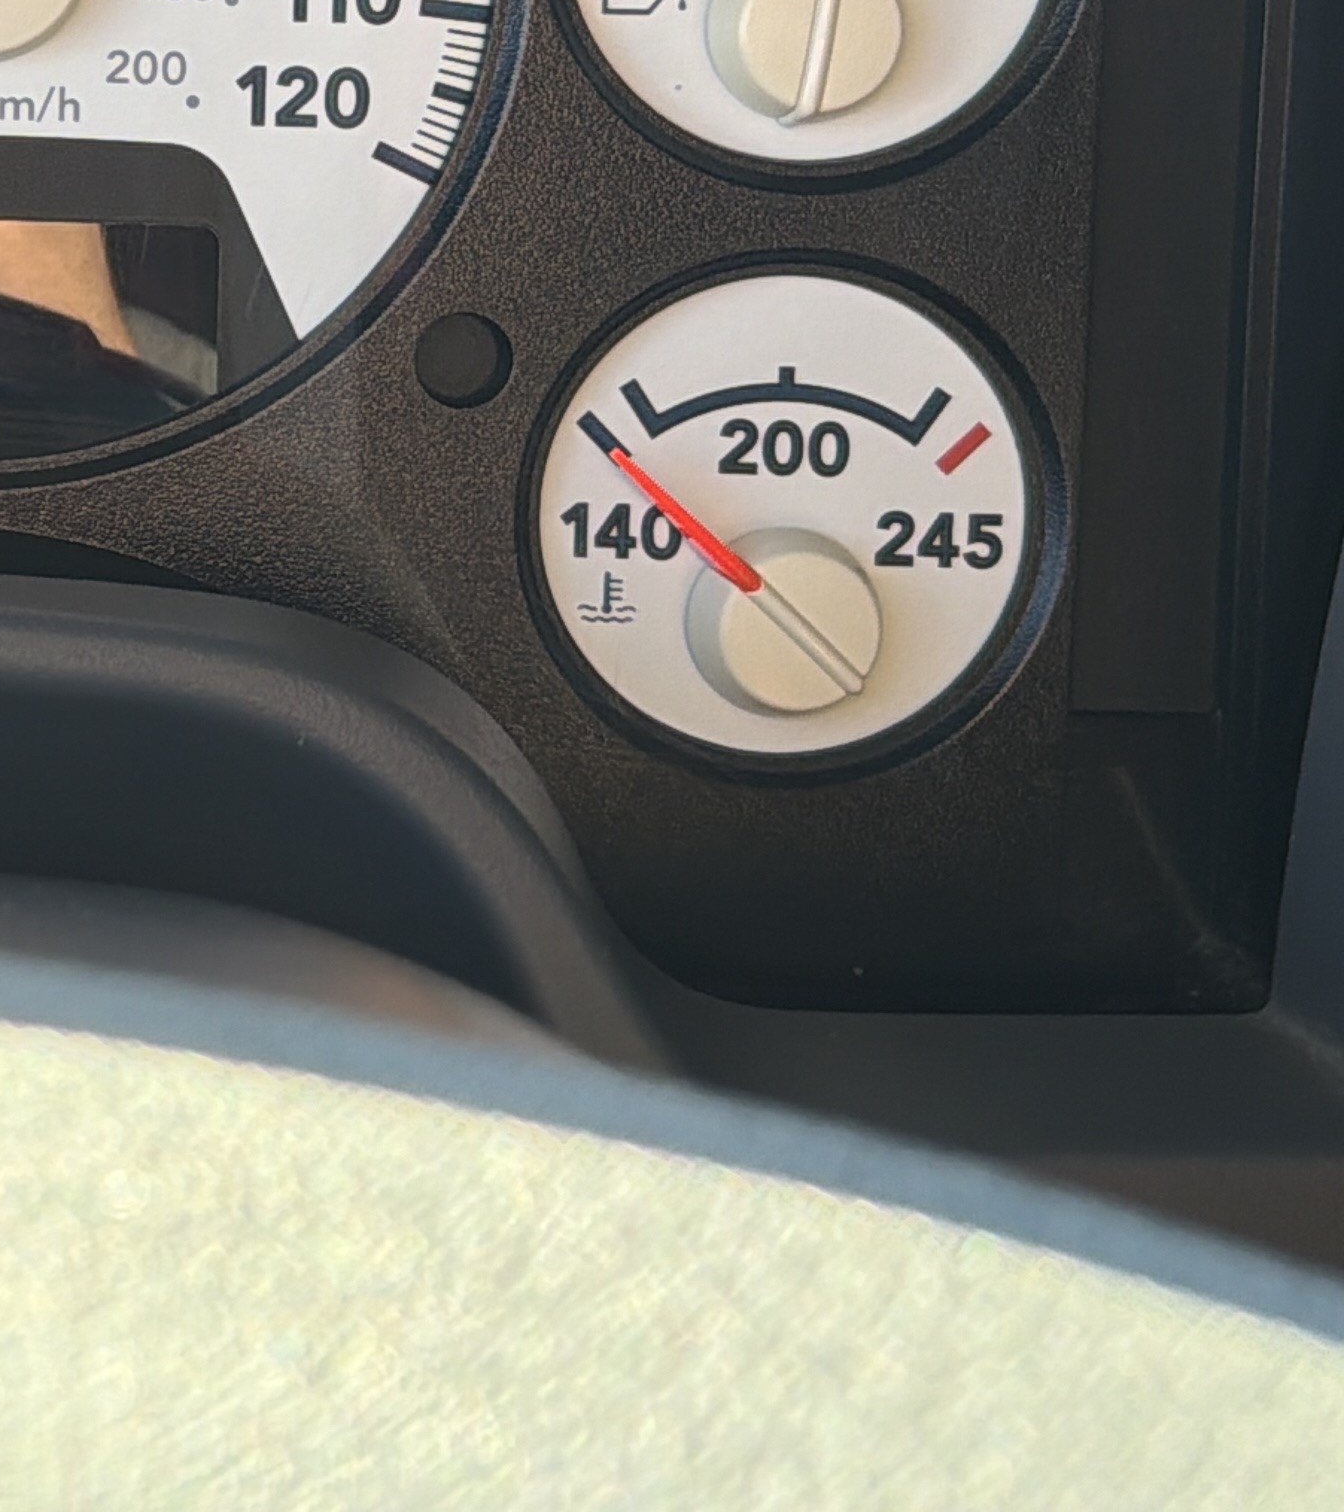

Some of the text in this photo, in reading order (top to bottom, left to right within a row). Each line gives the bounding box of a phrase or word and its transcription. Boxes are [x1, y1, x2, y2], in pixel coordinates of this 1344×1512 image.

[105, 50, 186, 85] 200
[236, 65, 370, 129] 120
[717, 419, 850, 477] 200
[560, 501, 683, 560] 140
[874, 511, 1003, 569] 245
